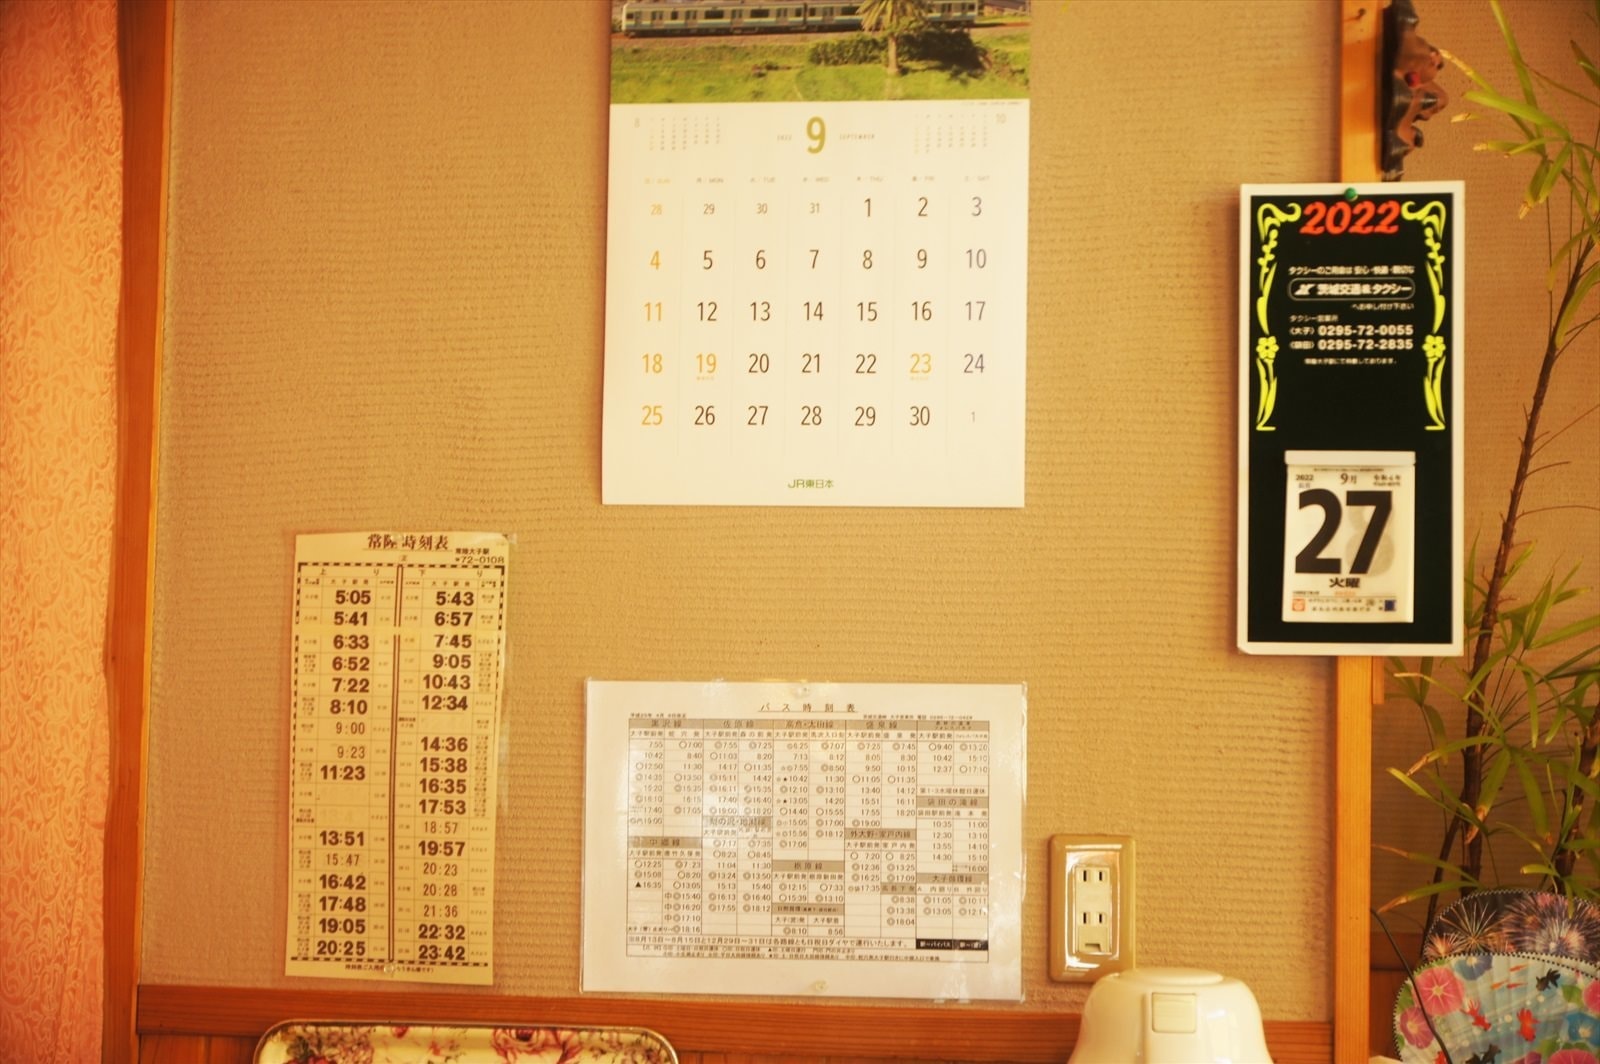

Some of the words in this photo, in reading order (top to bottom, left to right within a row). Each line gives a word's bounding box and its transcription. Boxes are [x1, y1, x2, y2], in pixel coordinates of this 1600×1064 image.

[806, 116, 827, 154] 9
[650, 204, 662, 216] 28
[703, 203, 715, 215] 29
[756, 203, 768, 215] 30
[809, 203, 820, 214] 31
[864, 198, 872, 217] 1
[917, 198, 929, 217] 2
[971, 197, 982, 217] 3
[1299, 200, 1401, 235] 2022
[649, 250, 661, 270] 4
[703, 250, 713, 269] 5
[755, 250, 766, 269] 6
[809, 250, 820, 269] 7
[862, 250, 873, 269] 8
[917, 249, 928, 269] 9
[965, 249, 987, 269] 10
[643, 302, 663, 322] 11
[697, 302, 717, 322] 12
[750, 302, 771, 322] 13
[803, 302, 824, 321] 14
[857, 302, 878, 321] 15
[911, 302, 932, 321] 16
[964, 301, 986, 321] 17
[1318, 325, 1413, 336] 0295-72-0055
[1318, 339, 1413, 350] 0295-72-2835
[641, 354, 663, 373] 18
[695, 354, 717, 373] 19
[748, 354, 770, 374] 20
[801, 354, 821, 373] 21
[855, 354, 877, 374] 22
[909, 354, 931, 373] 23
[963, 354, 985, 373] 24
[641, 406, 663, 426] 25
[694, 406, 716, 425] 26
[747, 406, 769, 426] 27
[800, 406, 822, 426] 28
[854, 407, 876, 426] 29
[909, 406, 931, 426] 30
[971, 412, 976, 423] 1
[788, 479, 834, 489] JR東日本
[1295, 488, 1393, 574] 27
[1329, 578, 1360, 588] 火曜
[336, 590, 371, 604] 5:05
[436, 592, 474, 606] 5:43
[334, 612, 368, 625] 5:41
[435, 612, 473, 626] 6:57
[333, 635, 369, 649] 6:33
[434, 635, 472, 648] 7:45
[332, 657, 369, 671] 6:52
[433, 655, 471, 668] 9:05
[332, 679, 369, 692] 7:22
[423, 675, 470, 690] 10:43
[330, 701, 367, 714] 8:10
[422, 695, 468, 710] 12:34
[336, 723, 365, 734] 9:00
[421, 737, 468, 751] 14:36
[337, 746, 365, 758] 9:23
[420, 758, 467, 772] 15:38
[321, 766, 365, 780] 11:23
[420, 779, 466, 794] 16:35
[419, 800, 466, 815] 17:53
[424, 822, 458, 834] 18:57
[319, 831, 364, 846] 13:51
[418, 841, 465, 856] 19:57
[326, 854, 360, 866] 15:47
[423, 863, 457, 876] 20:23
[319, 875, 366, 890] 16:42
[423, 884, 457, 896] 20:28
[319, 897, 366, 912] 17:48
[424, 906, 457, 918] 21:36
[319, 918, 365, 933] 19:05
[418, 925, 465, 940] 22:32
[317, 940, 365, 955] 20:25
[418, 945, 465, 960] 23:42
